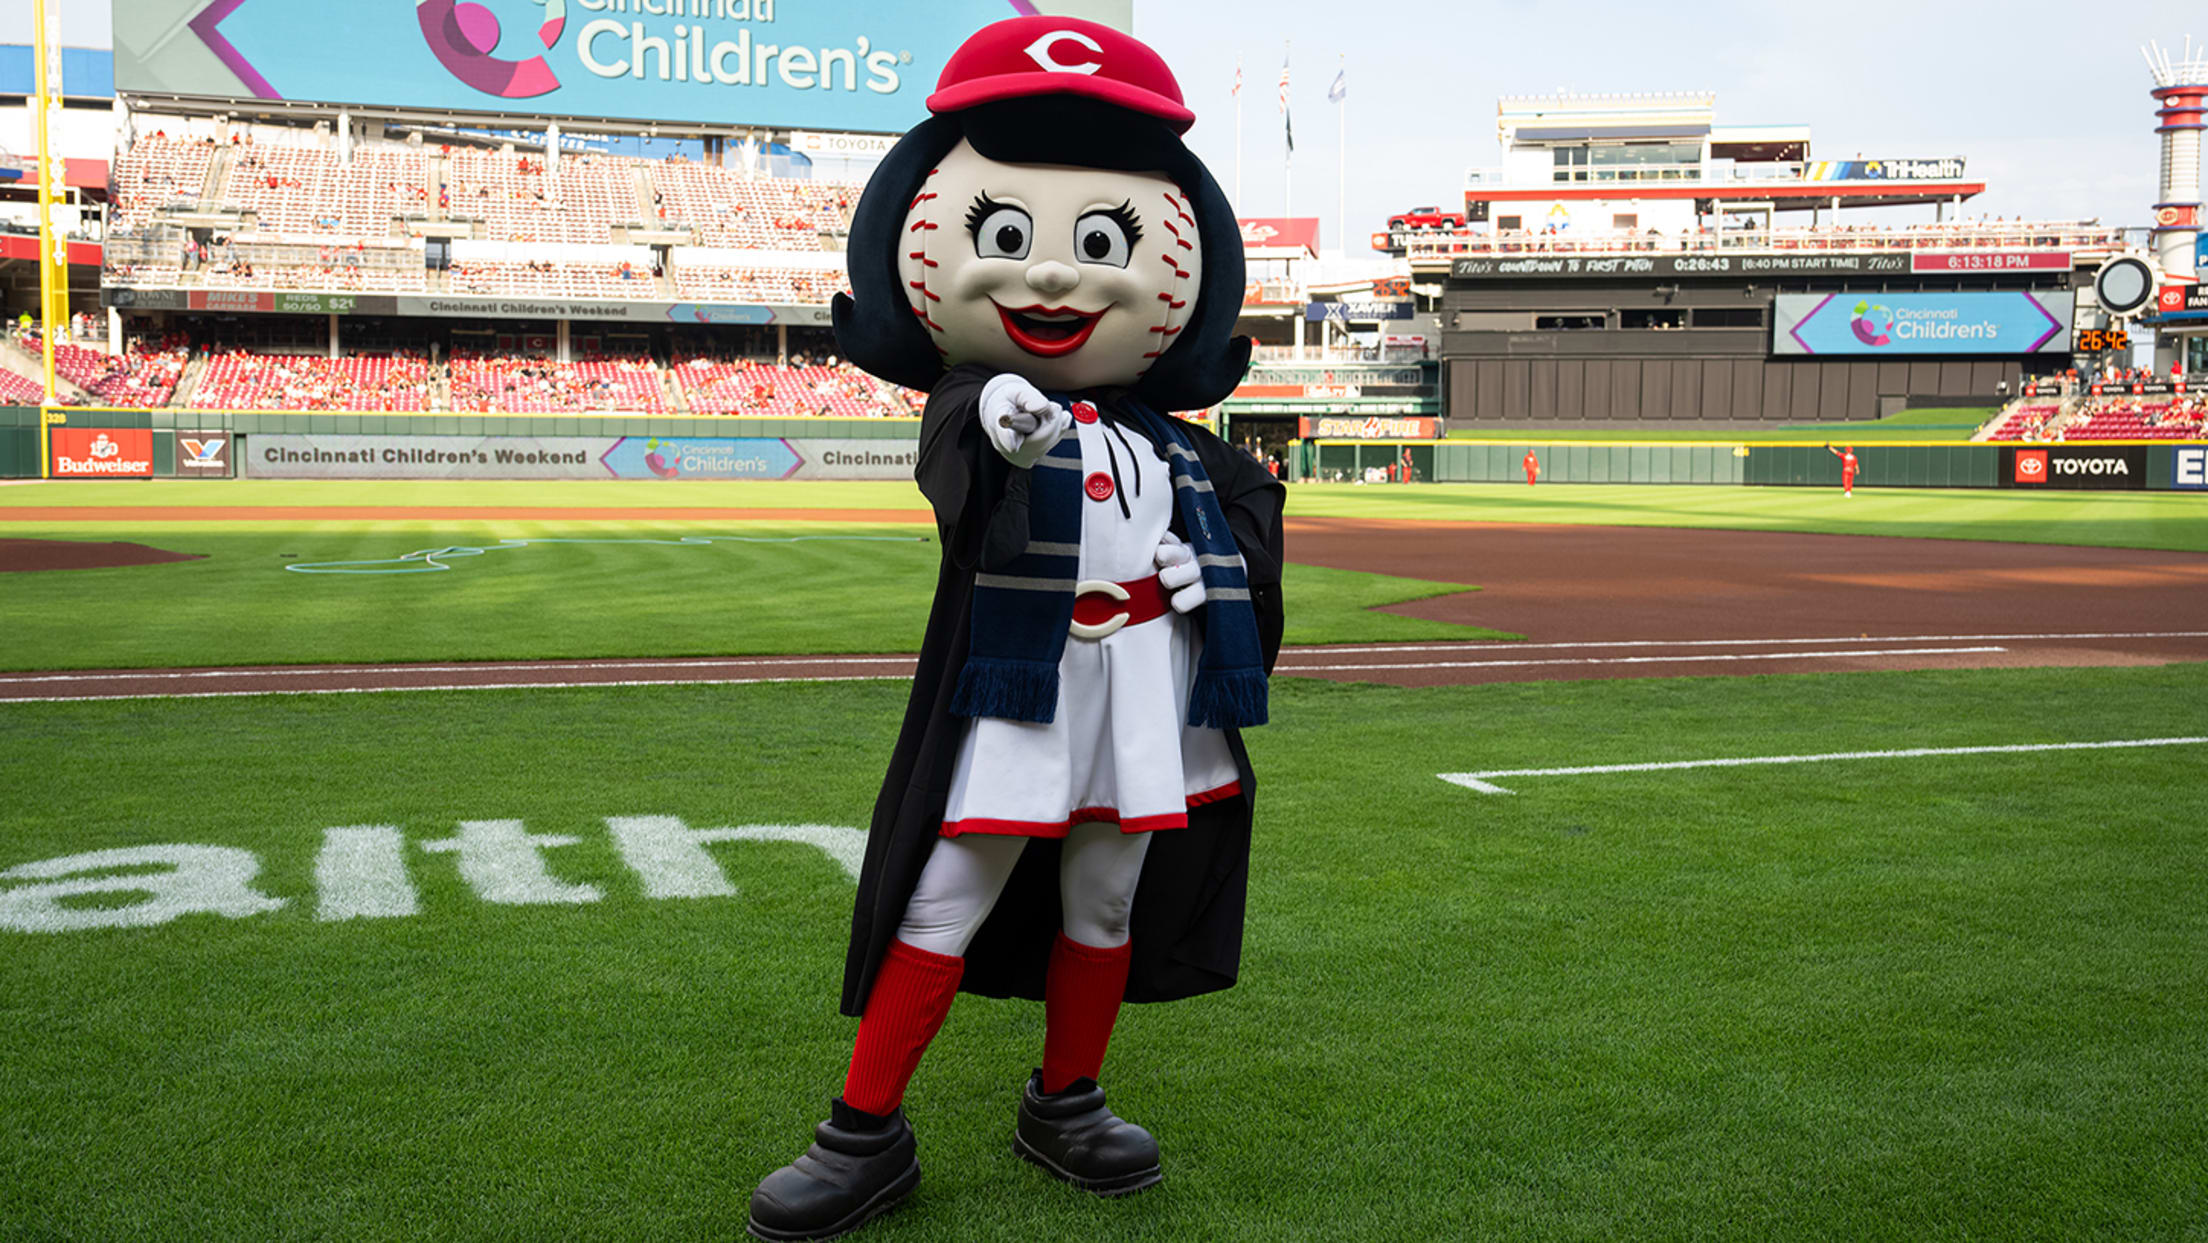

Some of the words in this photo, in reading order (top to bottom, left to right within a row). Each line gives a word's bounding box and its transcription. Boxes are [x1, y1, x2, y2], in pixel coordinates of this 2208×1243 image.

[577, 18, 901, 95] Children's
[828, 137, 887, 151] TOYOTA
[1882, 159, 1963, 179] TriHealth
[1458, 260, 1493, 274] Tito's
[1499, 259, 1564, 273] COUNTDOWN
[1567, 259, 1582, 273] TO
[1586, 259, 1625, 272] FIRST
[1624, 258, 1655, 272] PITCH
[1674, 258, 1730, 271] 0:26:43
[1772, 258, 1790, 269] PM
[1791, 257, 1827, 269] START
[1867, 256, 1905, 270] Tito's
[1948, 255, 2003, 268] 6:13:18
[2006, 255, 2030, 268] PM
[430, 301, 498, 313] Cincinnati
[501, 302, 566, 314] Children's
[570, 304, 628, 316] Weekend
[1896, 308, 1958, 320] Cincinnati
[1896, 320, 1998, 339] Children's
[2080, 330, 2128, 350] 26:42
[264, 447, 375, 464] Cincinnati
[382, 447, 488, 464] Children's
[494, 448, 587, 464] Weekend
[683, 455, 768, 472] Children's
[823, 450, 918, 465] Cincinnati
[57, 457, 149, 473] Budweiser
[2052, 458, 2129, 475] TOYOTA
[2177, 449, 2208, 484] E
